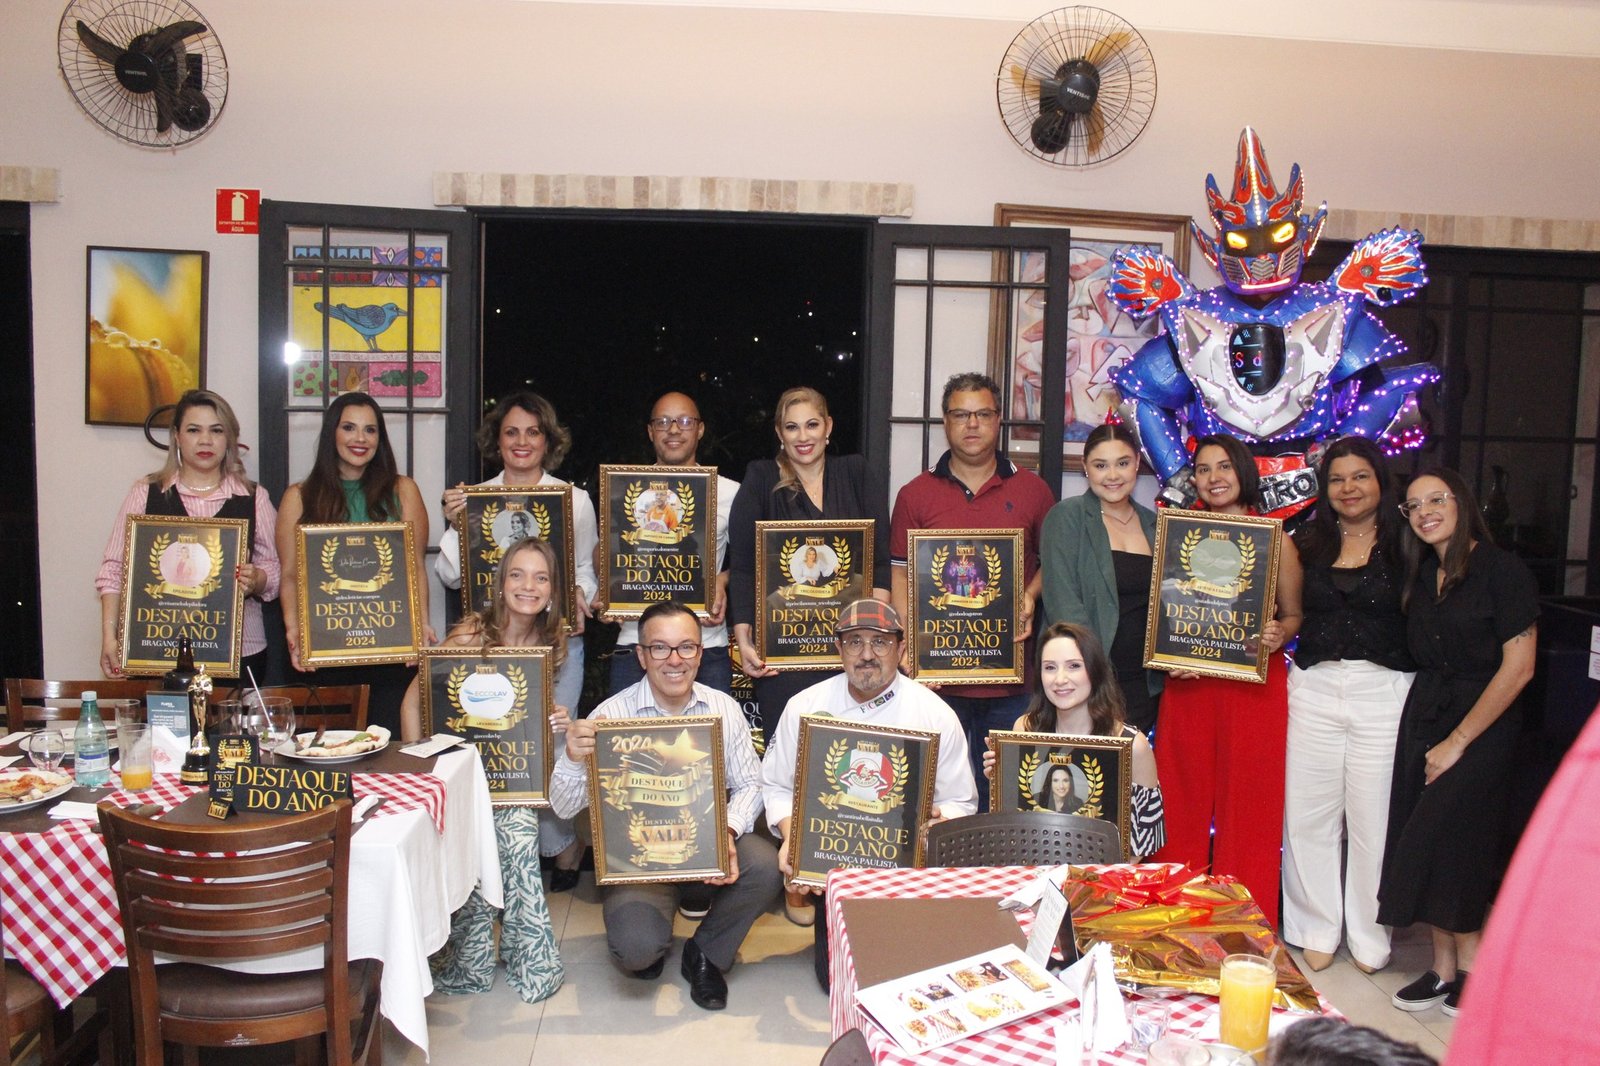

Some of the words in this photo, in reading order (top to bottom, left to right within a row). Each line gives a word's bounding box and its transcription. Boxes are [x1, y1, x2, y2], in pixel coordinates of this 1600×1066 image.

[616, 554, 700, 570] DESTAQUE
[626, 569, 651, 583] DO
[655, 569, 692, 583] ANO
[622, 584, 661, 592] BRAGANÇA
[643, 592, 672, 601] 2024
[315, 601, 403, 617] DESTAQUE
[1166, 603, 1255, 628] DESTAQUE
[137, 608, 226, 627] DESTAQUE
[326, 616, 352, 630] DO
[356, 615, 395, 629] ANO
[146, 624, 173, 639] DO
[177, 625, 217, 640] ANO
[782, 623, 806, 636] DO
[924, 619, 1008, 635] DESTAQUE
[1175, 620, 1201, 636] DO
[1204, 625, 1246, 642] ANO
[141, 640, 179, 648] BRAGANÇ
[346, 637, 376, 646] 2024
[777, 638, 816, 646] BRAGANÇA
[934, 635, 959, 648] DO
[962, 634, 1000, 648] ANO
[1169, 635, 1210, 647] BRAGANÇA
[1210, 640, 1246, 651] PAULISTA
[799, 645, 828, 654] 2024
[929, 650, 969, 658] BRAGANÇA
[1191, 645, 1222, 658] 2024
[951, 657, 981, 667] 2024
[611, 734, 653, 753] 2024
[486, 756, 527, 771] ANO
[236, 766, 346, 795] DESTAQUE
[489, 780, 506, 789] 24
[631, 777, 685, 788] DESTAQUE
[247, 788, 280, 810] DO
[284, 792, 335, 813] ANO
[660, 793, 680, 802] ANO
[641, 828, 689, 843] VALE
[810, 817, 909, 845] DESTAQUE
[819, 836, 848, 854] DO
[852, 842, 897, 860] ANO
[814, 851, 858, 864] BRAGANÇA
[859, 857, 899, 869] PAULISTA
